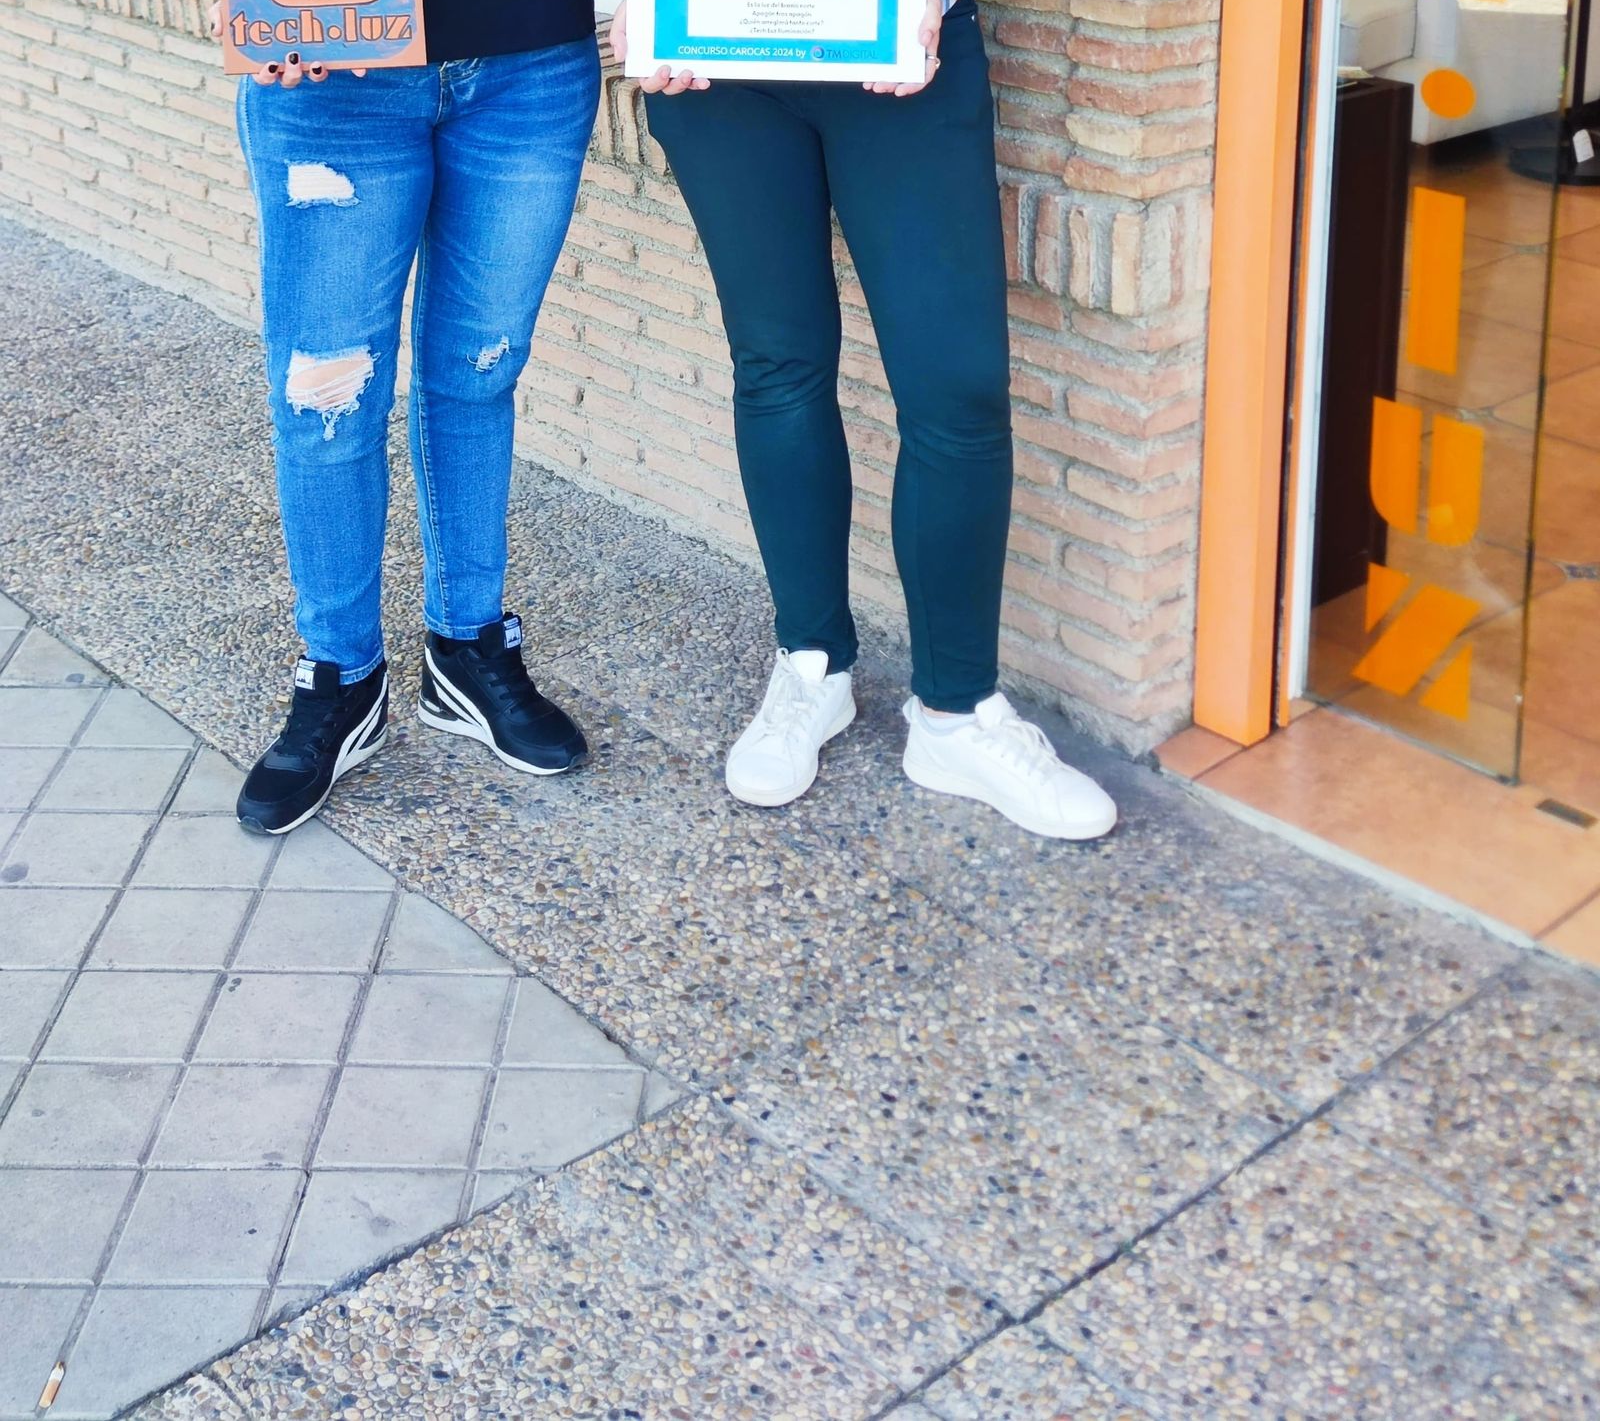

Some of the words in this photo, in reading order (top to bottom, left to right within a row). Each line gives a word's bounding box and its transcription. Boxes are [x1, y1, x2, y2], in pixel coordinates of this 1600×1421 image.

[678, 45, 728, 56] CONCURSO
[730, 46, 770, 57] CAROCAS
[772, 47, 793, 58] 2024
[795, 47, 806, 59] by
